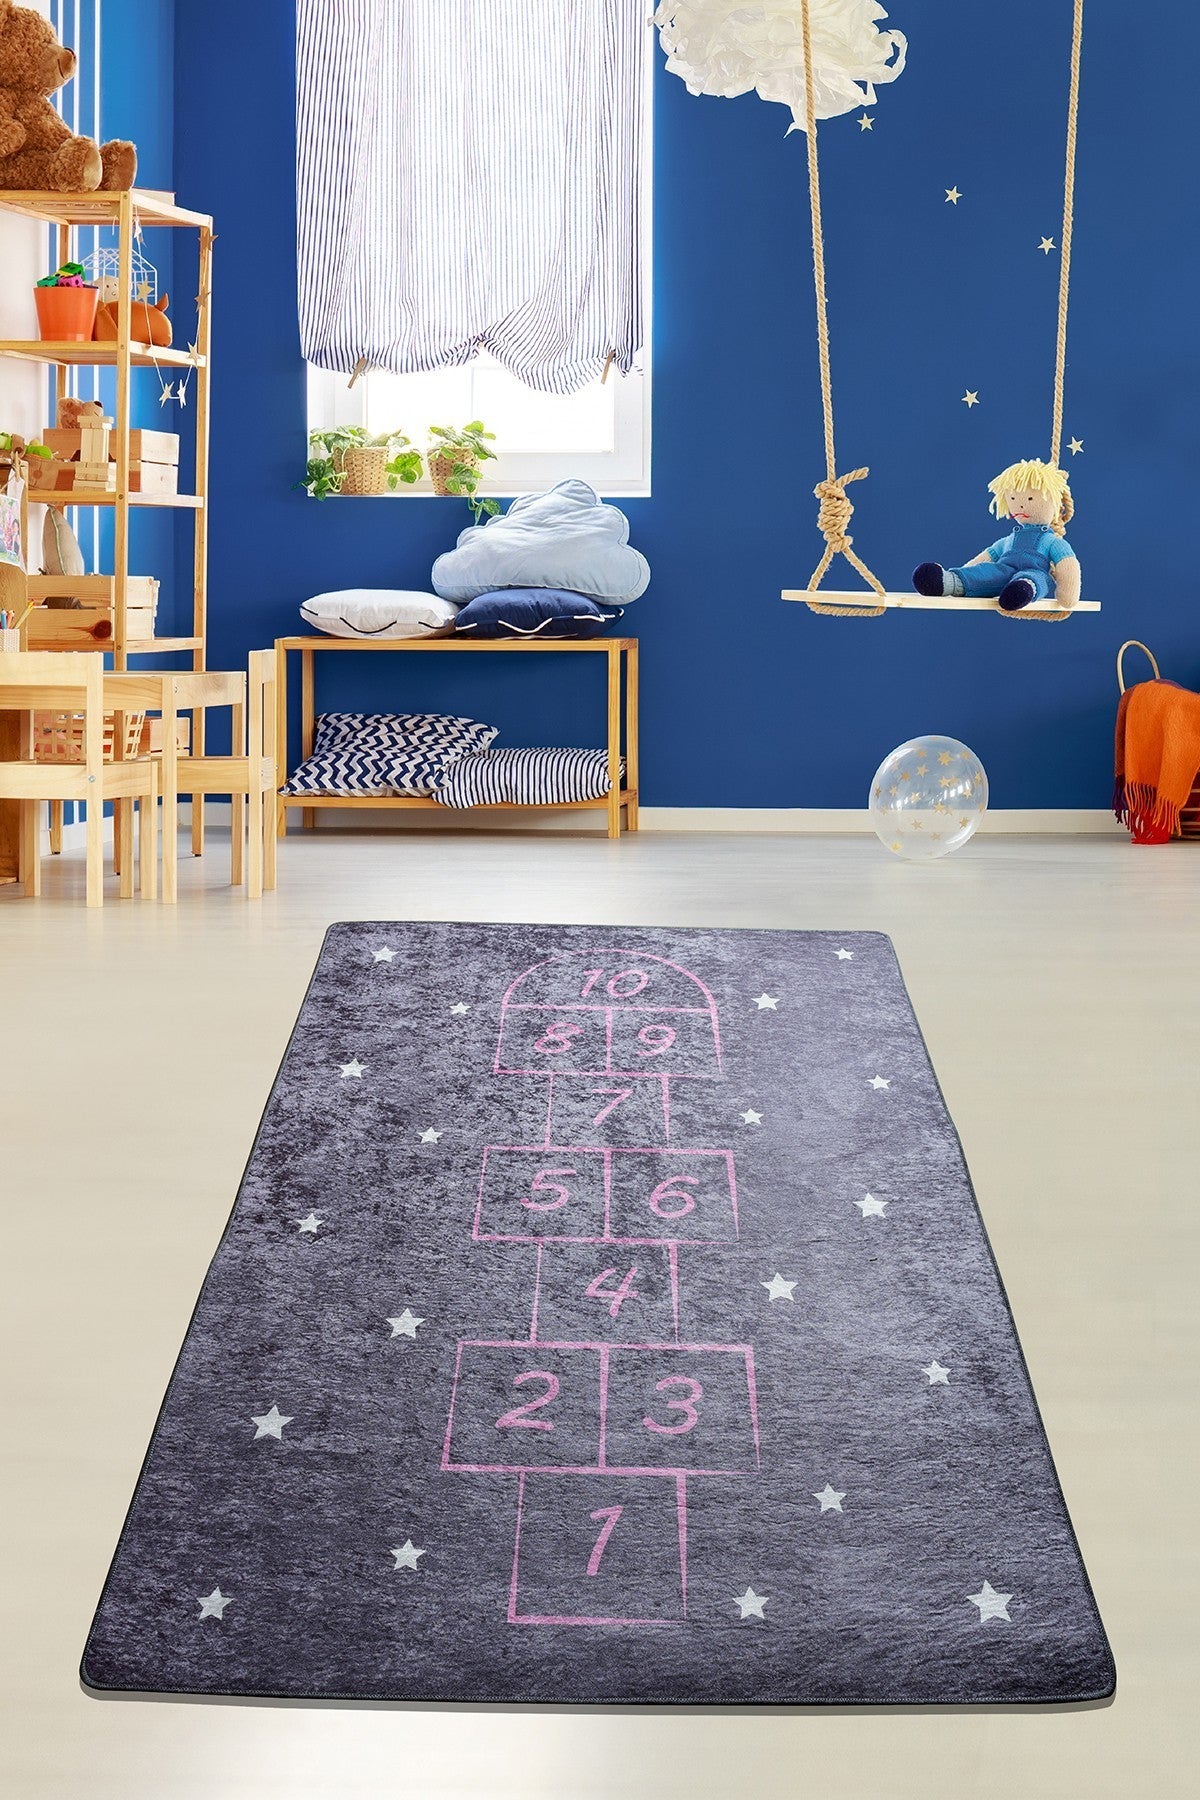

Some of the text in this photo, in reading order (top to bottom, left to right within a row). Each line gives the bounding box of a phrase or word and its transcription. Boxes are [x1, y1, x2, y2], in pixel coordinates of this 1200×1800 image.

[581, 969, 649, 998] 10
[534, 1023, 585, 1054] 8
[637, 1025, 676, 1056] 9
[591, 1089, 633, 1125] 7
[520, 1169, 577, 1211] 5
[649, 1175, 699, 1218] 6
[585, 1267, 638, 1317] 4
[495, 1371, 560, 1431] 2
[642, 1376, 703, 1434] 3
[586, 1505, 624, 1576] 1
